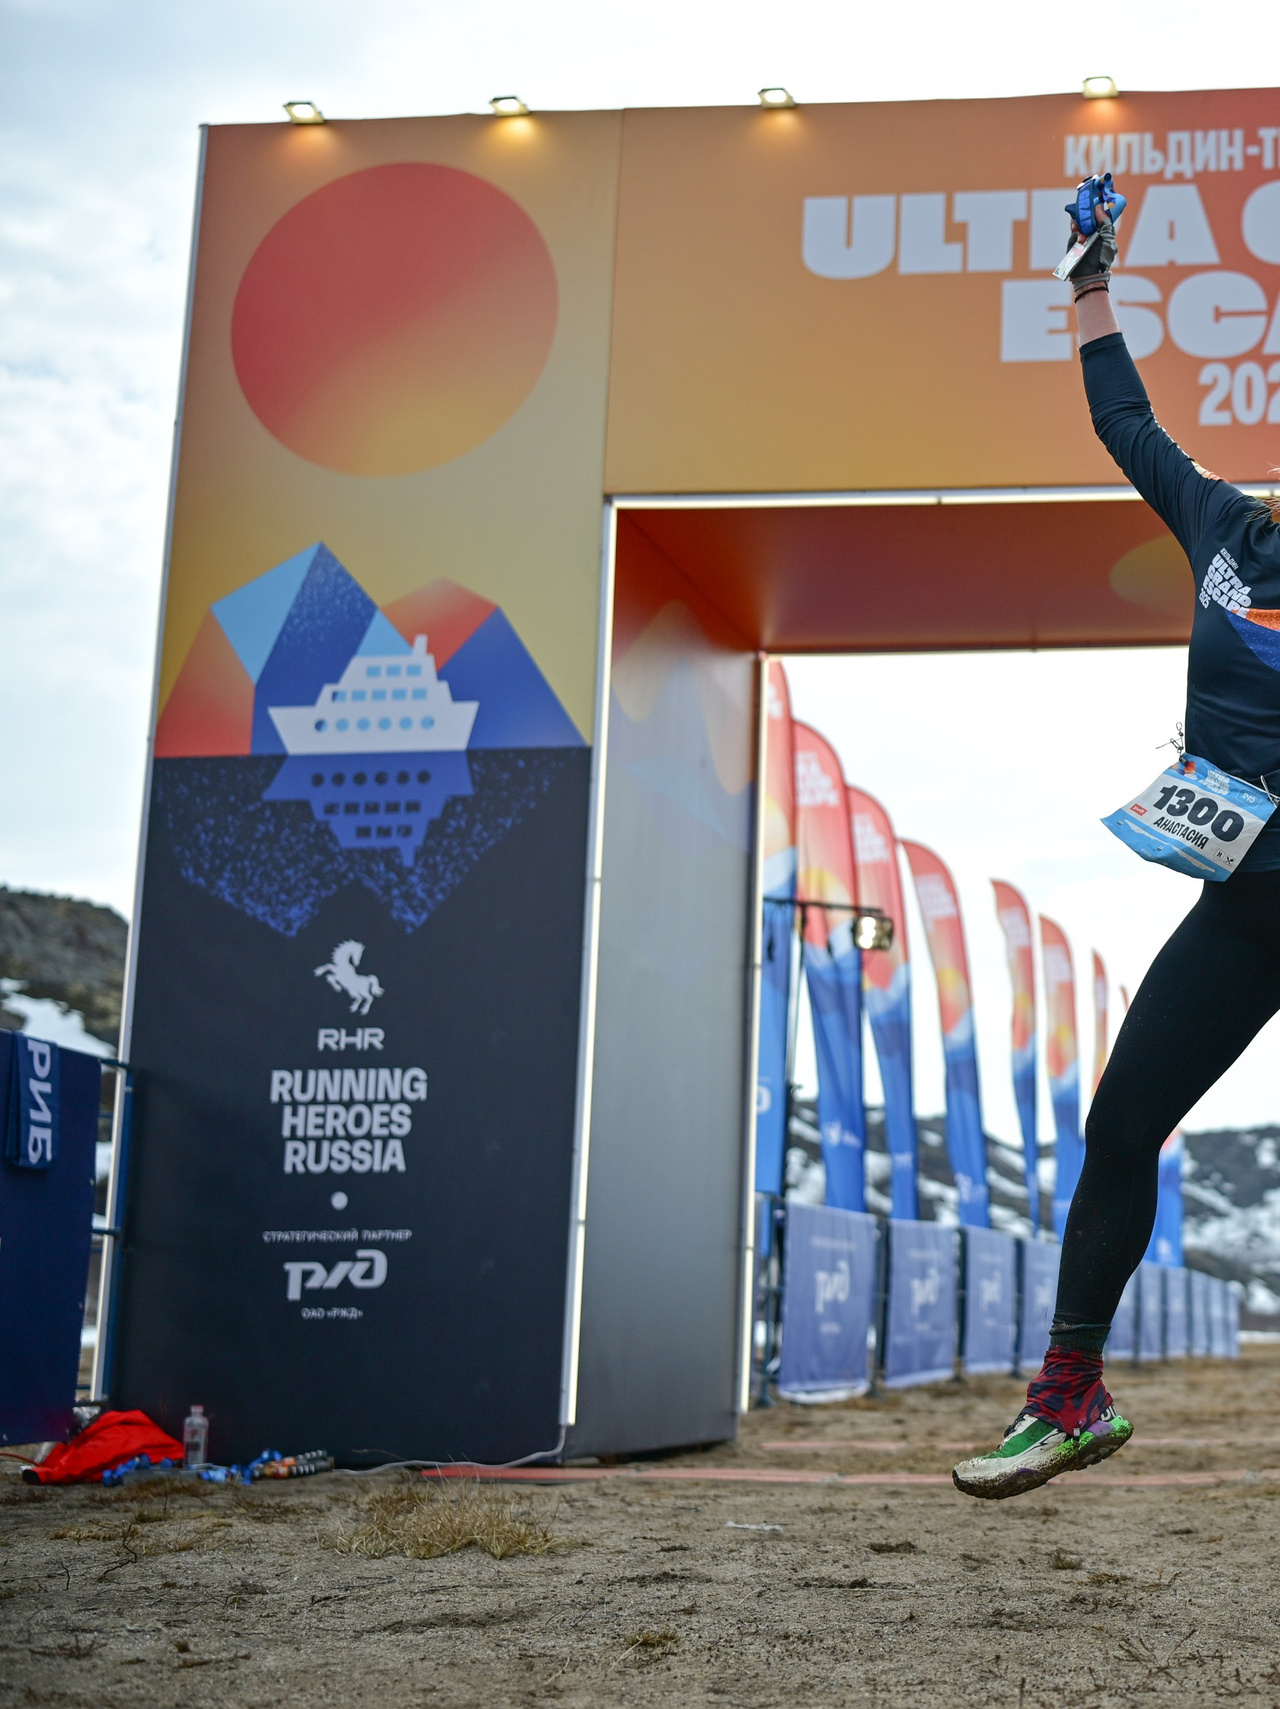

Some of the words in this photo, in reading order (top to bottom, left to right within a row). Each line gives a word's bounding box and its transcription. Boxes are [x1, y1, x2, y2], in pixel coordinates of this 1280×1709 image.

[1207, 564, 1251, 607] GRAND
[1212, 553, 1251, 595] ULTRA
[1202, 574, 1250, 619] ESCAPE
[1153, 785, 1245, 842] 1300
[1153, 816, 1209, 850] АНАСТАСИЯ
[317, 1027, 385, 1051] RHR
[270, 1067, 428, 1103] RUNNING
[281, 1102, 412, 1138] HEROES
[284, 1139, 406, 1174] RUSSIA
[262, 1228, 358, 1242] СТРАТЕГИЧЕСКИЙ
[362, 1229, 412, 1241] ПАРТНЕР
